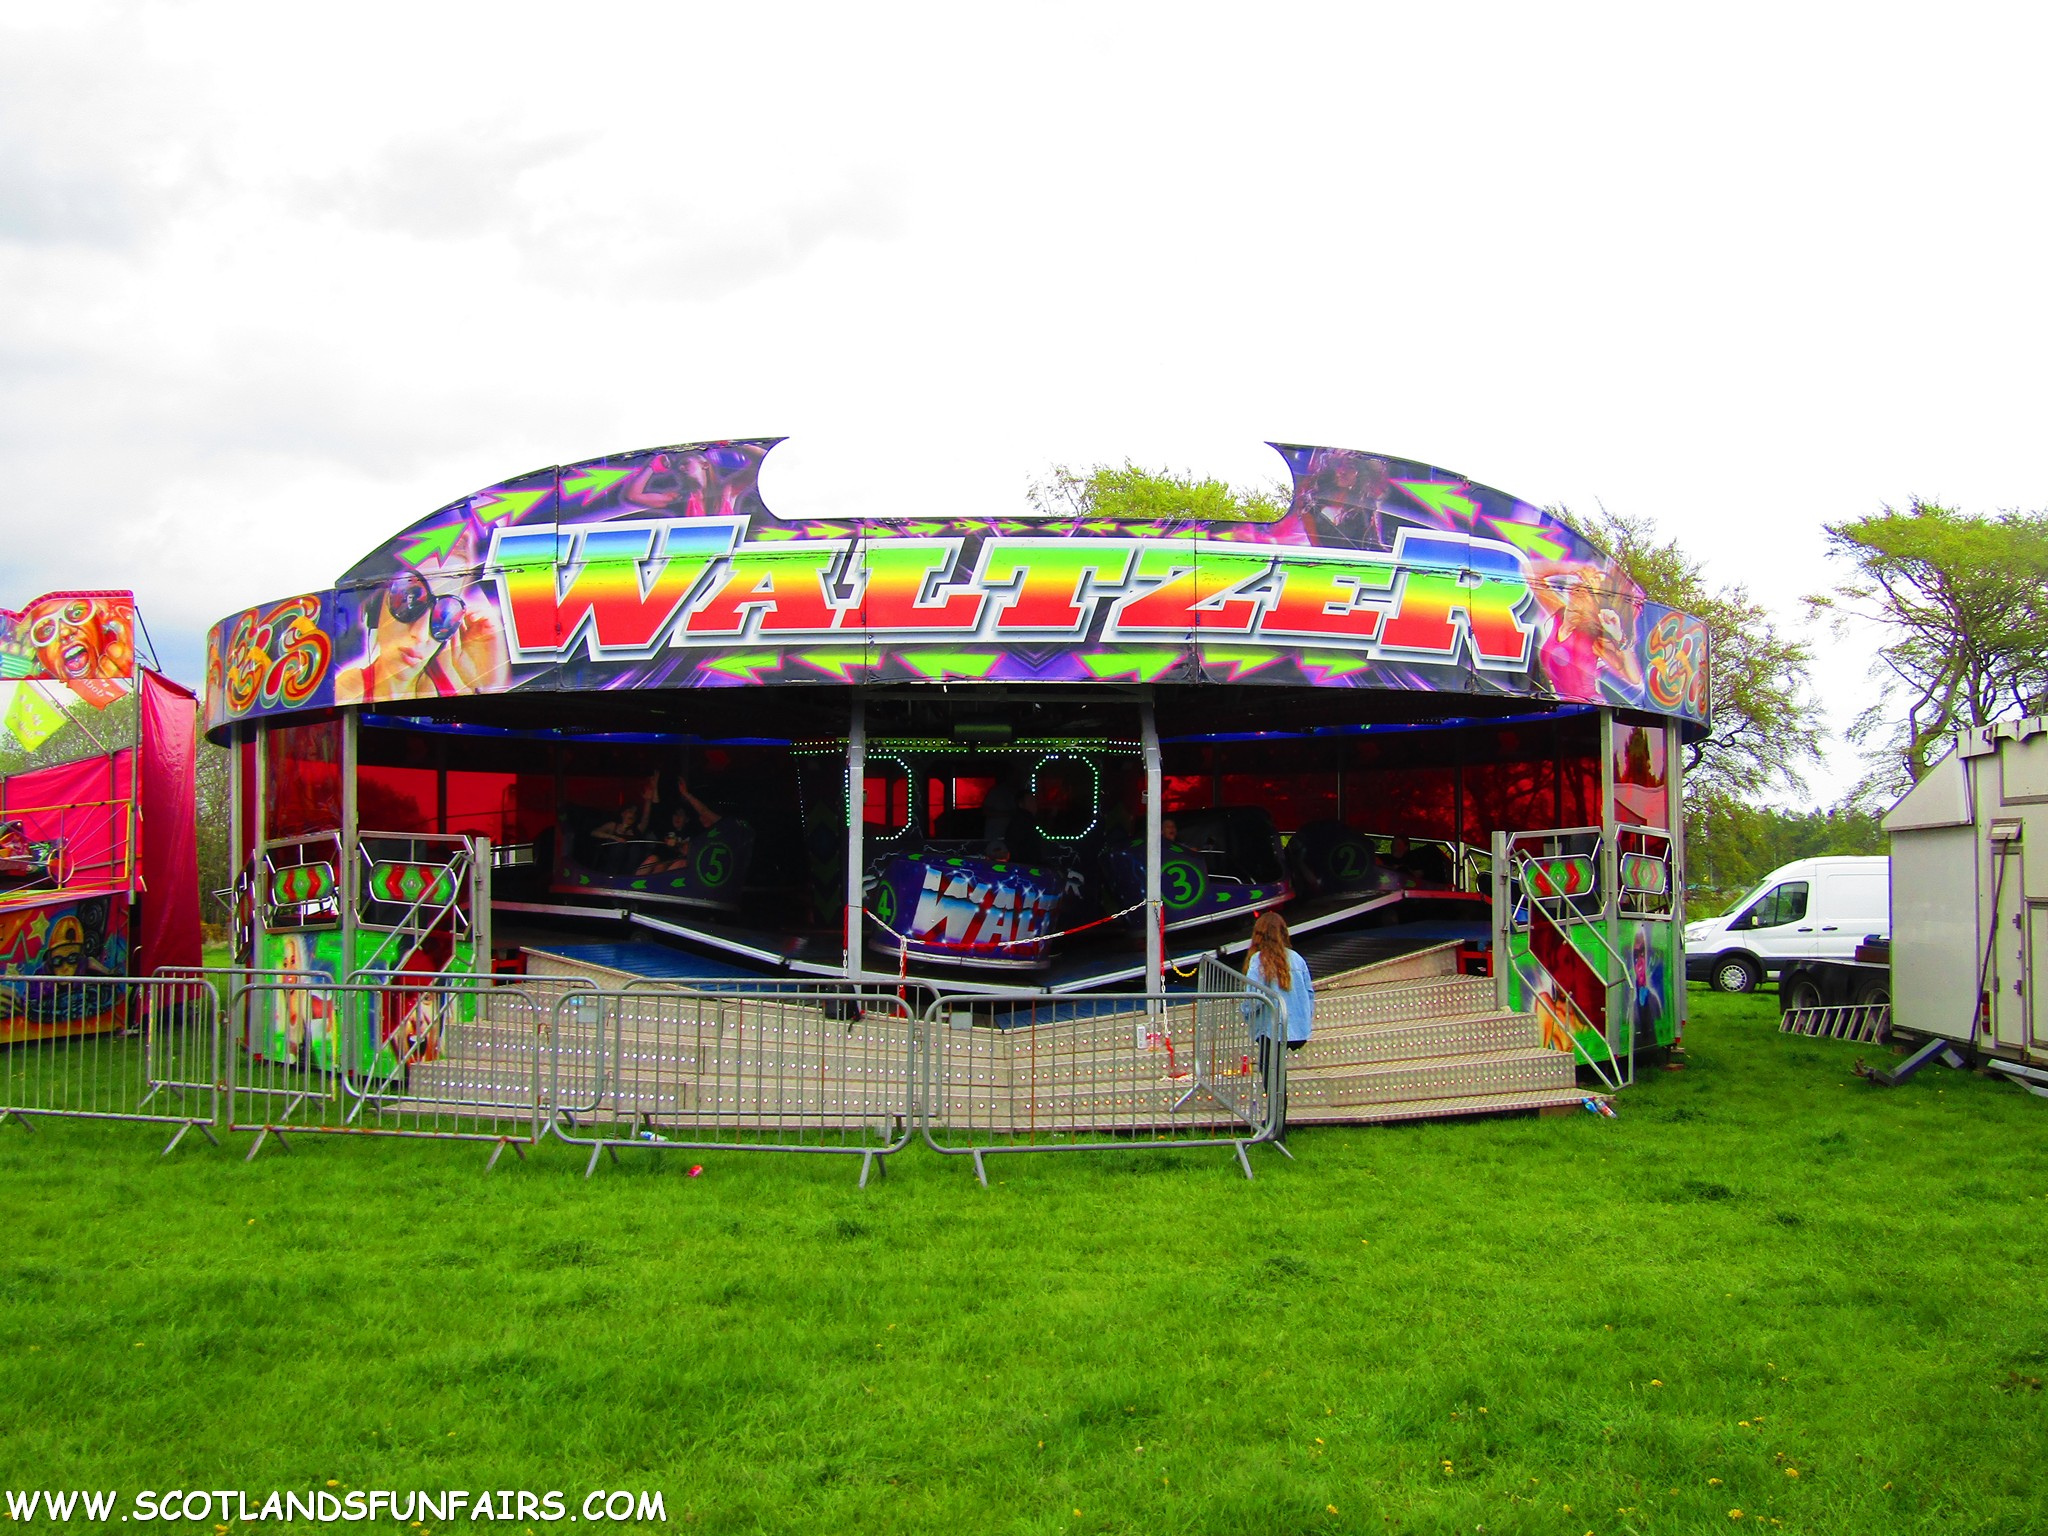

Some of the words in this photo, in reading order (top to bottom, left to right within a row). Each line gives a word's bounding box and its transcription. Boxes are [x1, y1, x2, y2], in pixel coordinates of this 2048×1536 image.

[482, 516, 1536, 673] WALTZER
[706, 848, 727, 881] 5
[1342, 850, 1360, 876] 2
[1167, 866, 1192, 901] 3
[877, 889, 892, 918] 4
